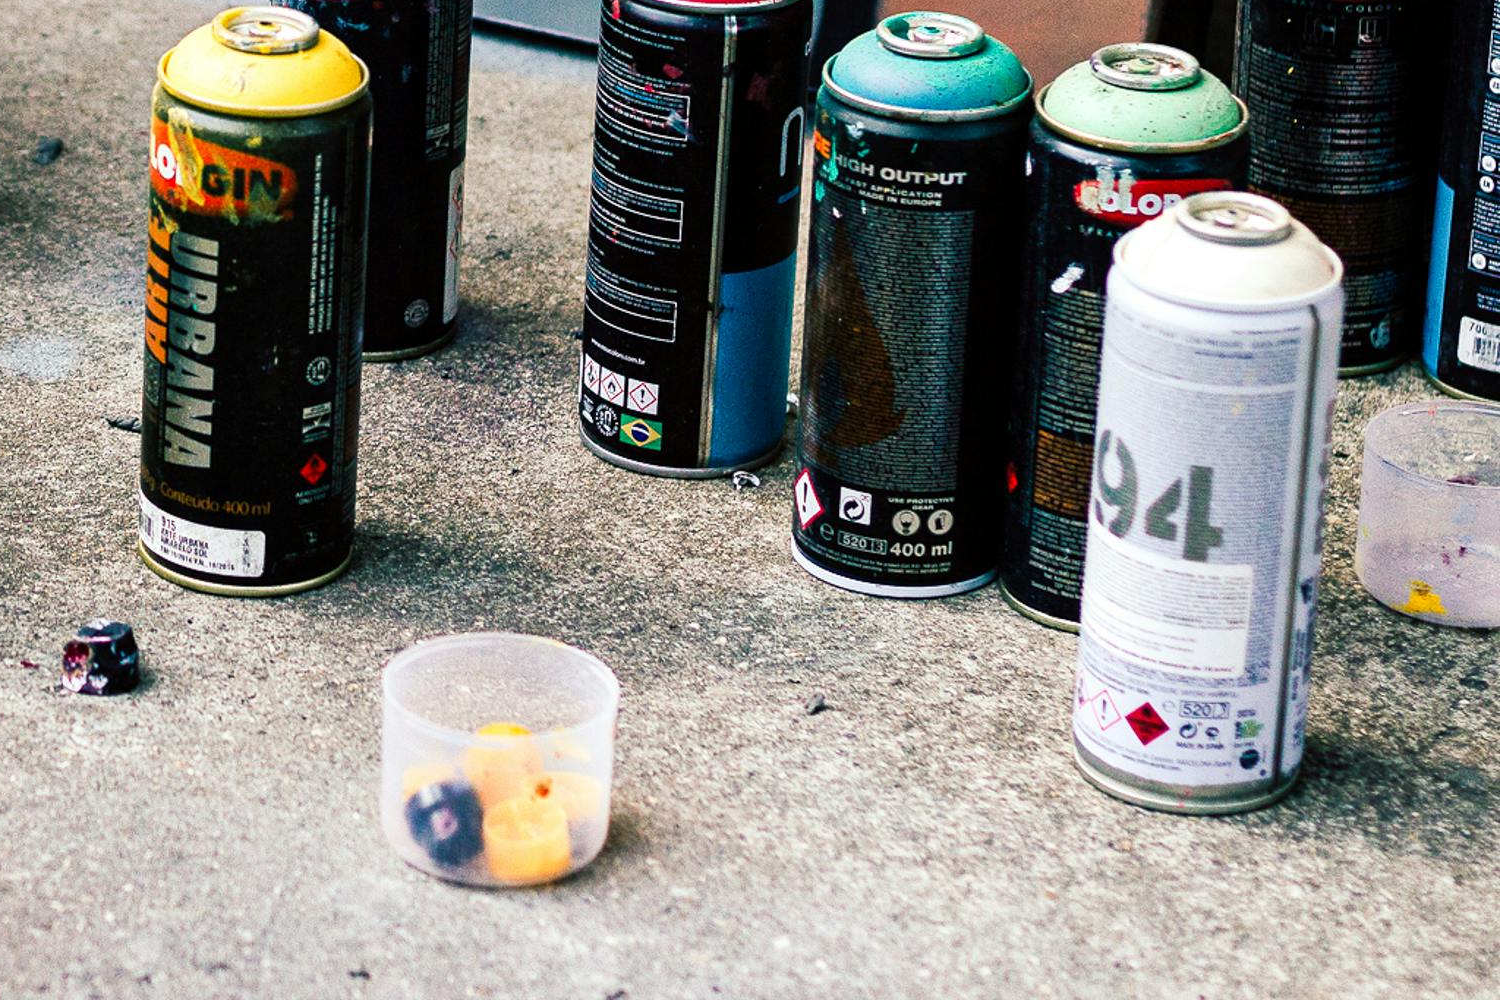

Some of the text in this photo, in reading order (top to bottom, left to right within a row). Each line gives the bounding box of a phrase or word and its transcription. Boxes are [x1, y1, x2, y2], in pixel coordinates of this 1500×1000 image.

[879, 167, 967, 185] OUTPUT
[163, 231, 219, 470] URBANA
[1095, 429, 1224, 563] 94
[222, 502, 249, 514] 400
[251, 502, 271, 515] ml
[843, 534, 868, 549] 520
[890, 541, 953, 556] 400 ml
[1183, 703, 1212, 717] 520
